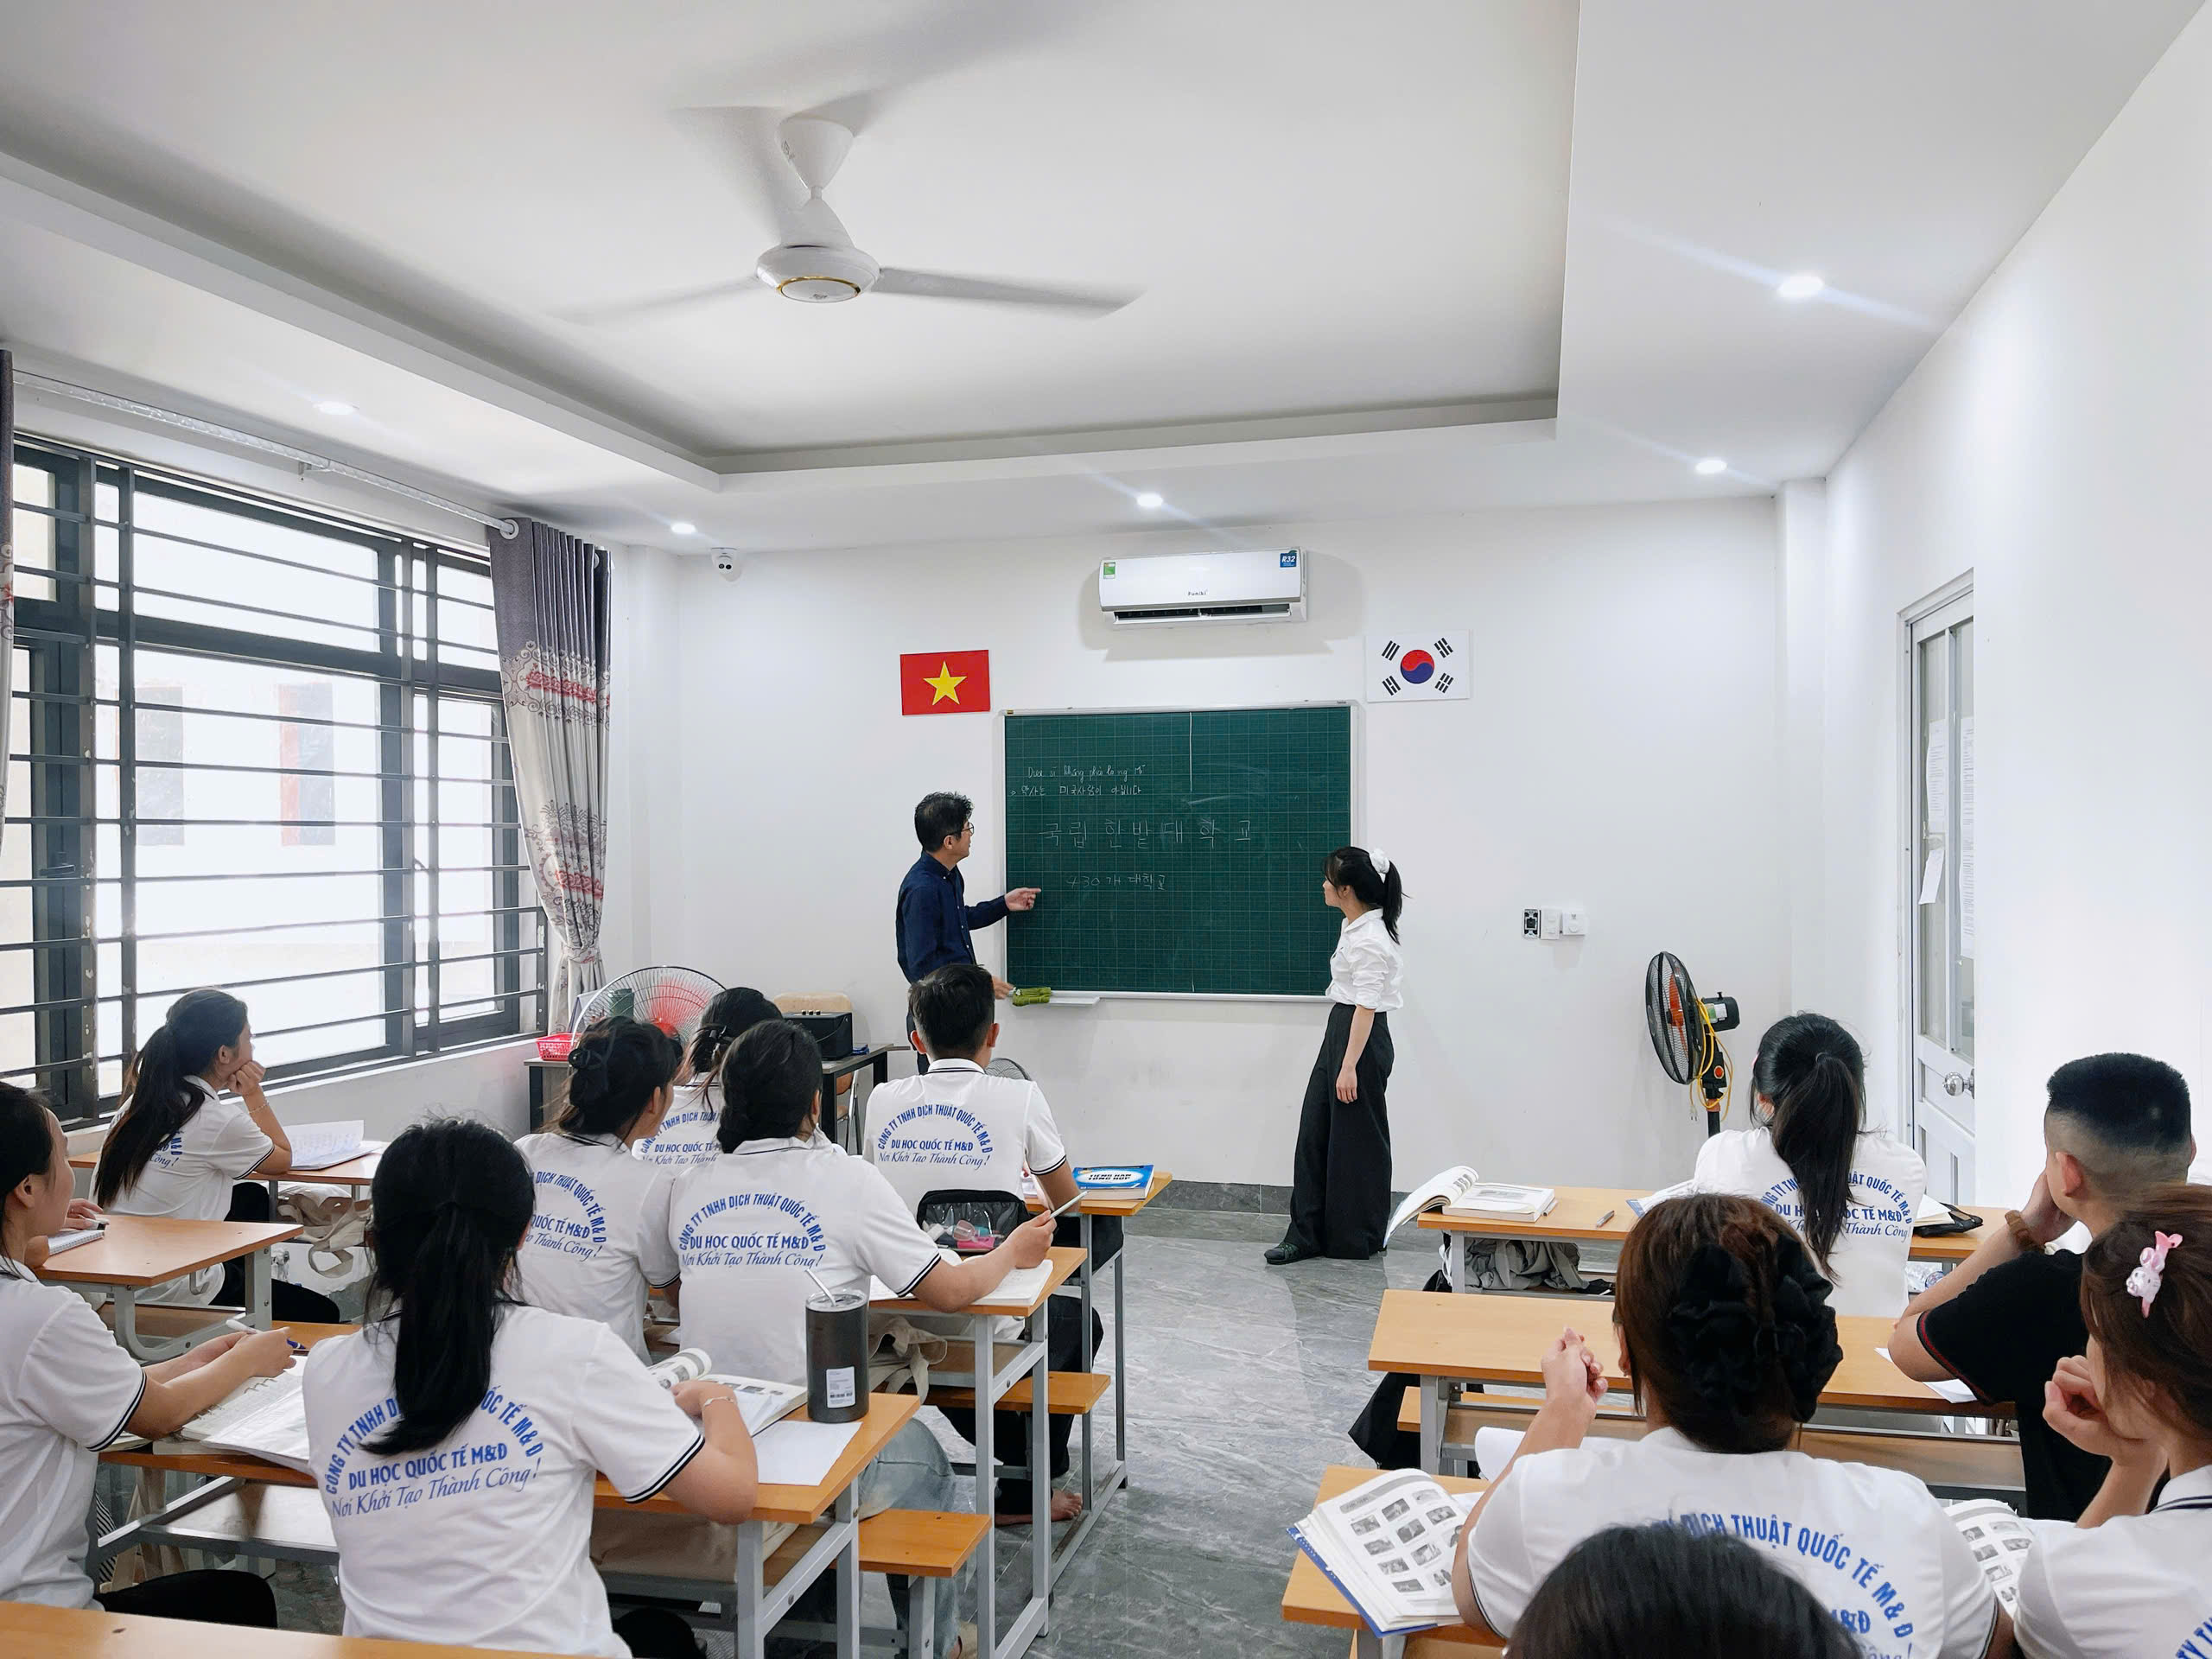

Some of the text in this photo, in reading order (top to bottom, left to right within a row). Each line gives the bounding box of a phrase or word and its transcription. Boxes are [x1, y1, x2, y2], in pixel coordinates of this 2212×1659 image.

[878, 1128, 892, 1149] CÔNG
[888, 1120, 899, 1131] TY
[897, 1109, 916, 1124] TNHH
[956, 1109, 976, 1127] QUỐC
[654, 1143, 664, 1152] DU
[683, 1141, 704, 1154] QUỐC
[891, 1139, 901, 1148] DU
[919, 1138, 941, 1151] QUỐC
[929, 1152, 957, 1165] Thành
[574, 1184, 595, 1206] QUỐC
[1770, 1184, 1787, 1197] TY
[1866, 1176, 1892, 1195] QUỐC
[1891, 1189, 1905, 1203] TẾ
[678, 1224, 695, 1250] CÔNG
[691, 1211, 702, 1227] TY
[701, 1198, 727, 1218] TNHH
[729, 1194, 751, 1210] DỊCH
[753, 1192, 782, 1210] THUẬT
[780, 1197, 804, 1218] QUỐC
[799, 1212, 820, 1227] TẾ
[1877, 1209, 1902, 1222] M&D
[555, 1217, 569, 1233] TẾ
[565, 1222, 590, 1238] M&D
[1846, 1221, 1882, 1236] Thành
[534, 1232, 565, 1250] Thành
[690, 1231, 809, 1251] DU HỌC QUỐC TẾ M&D
[696, 1250, 723, 1266] Khởi
[723, 1253, 743, 1268] Tạo
[747, 1251, 782, 1266] Thành
[325, 1453, 346, 1494] CÔNG
[337, 1433, 355, 1456] TY
[348, 1404, 386, 1441] TNHH
[480, 1385, 503, 1414] ỐC
[498, 1402, 528, 1426] TẾ
[349, 1442, 507, 1491] DU HỌC QUỐC TẾ M&D
[332, 1497, 353, 1518] Nơi
[357, 1490, 391, 1516] Khởi
[396, 1485, 423, 1509] Tạo
[428, 1469, 481, 1500] Thành
[1731, 1513, 1792, 1548] THUẬT
[1797, 1526, 1851, 1570] QUỐC
[1852, 1557, 1885, 1588] TẾ
[1831, 1609, 1871, 1634] &D
